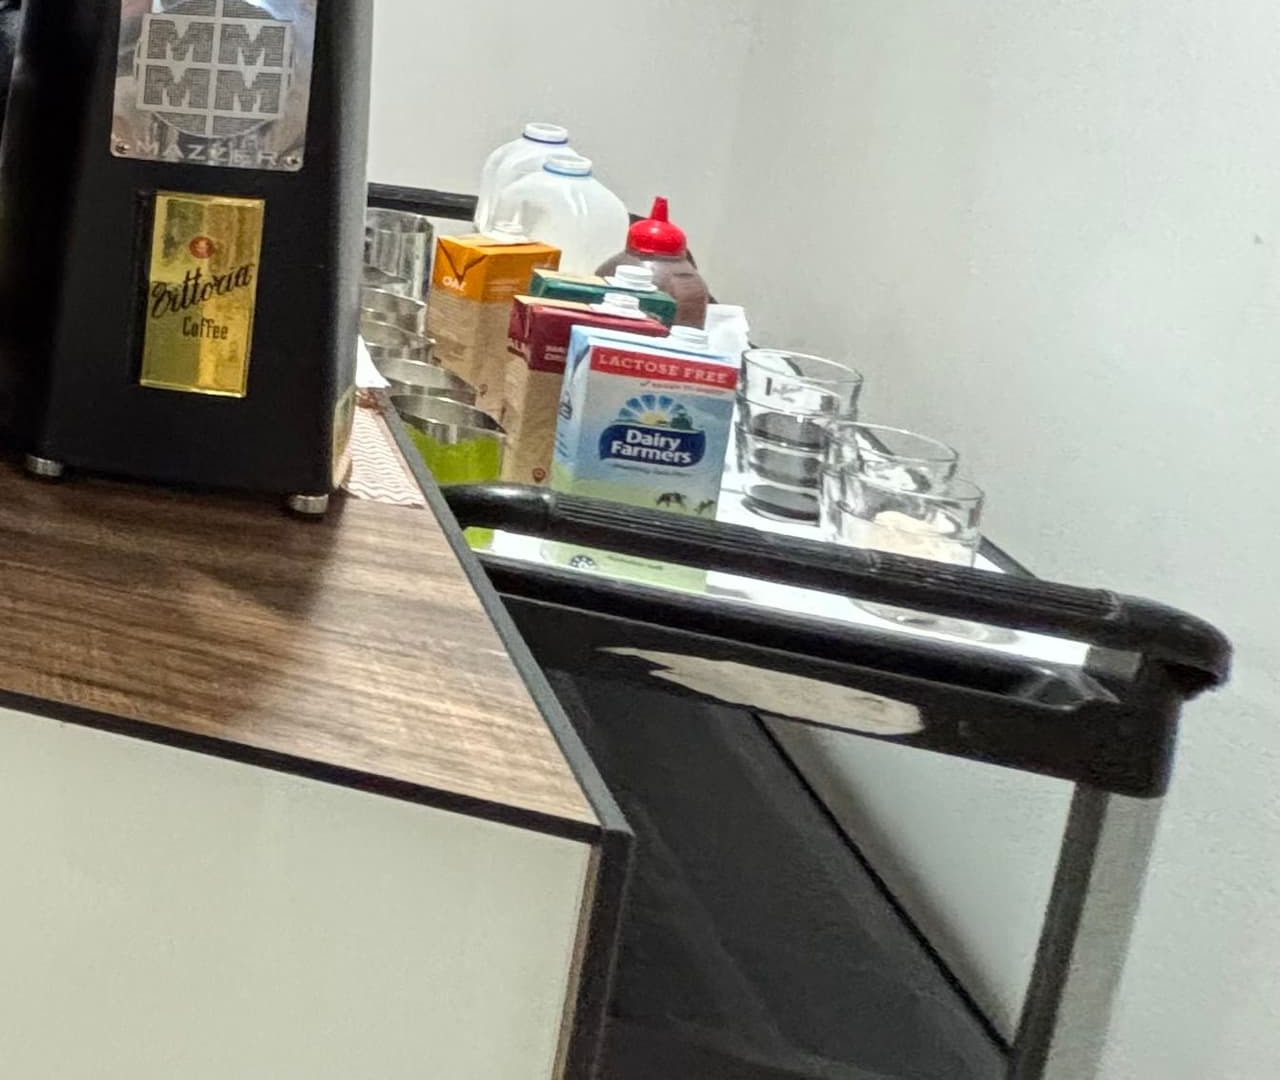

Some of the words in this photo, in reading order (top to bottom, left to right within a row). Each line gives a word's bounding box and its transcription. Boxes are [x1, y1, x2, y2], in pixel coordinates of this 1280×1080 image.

[150, 263, 256, 319] Vittoria
[182, 316, 229, 340] Coffee
[597, 353, 680, 377] LACTOSE
[683, 367, 729, 384] FREE
[626, 428, 681, 451] Dairy
[610, 440, 692, 465] Farmers
